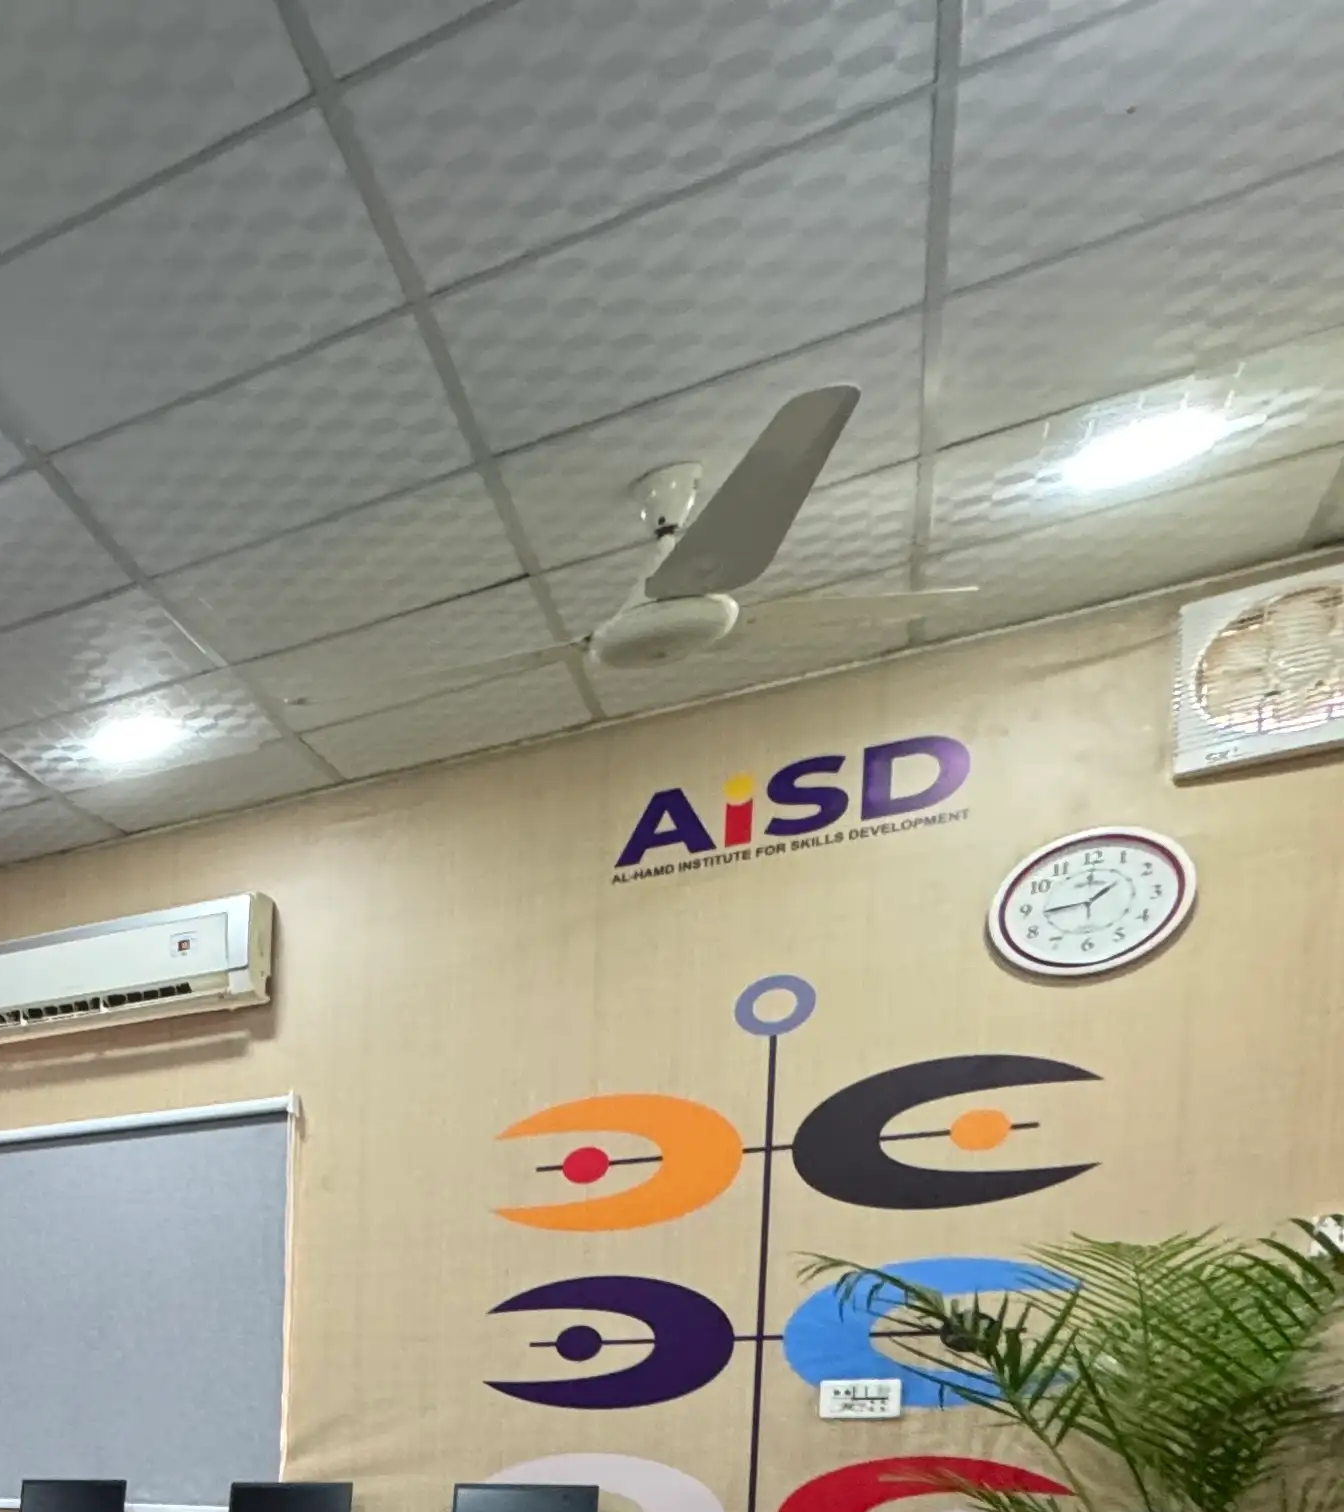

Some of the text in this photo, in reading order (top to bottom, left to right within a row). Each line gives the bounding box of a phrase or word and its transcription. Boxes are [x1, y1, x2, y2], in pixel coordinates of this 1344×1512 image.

[611, 808, 971, 885] AL-HAMD INSTITUTE FOR SKILLS DEVELOPMENT
[1083, 850, 1105, 866] 12
[1119, 850, 1128, 864] 1
[1051, 861, 1070, 877] 11
[1030, 878, 1052, 895] 10
[1019, 903, 1033, 918] 9
